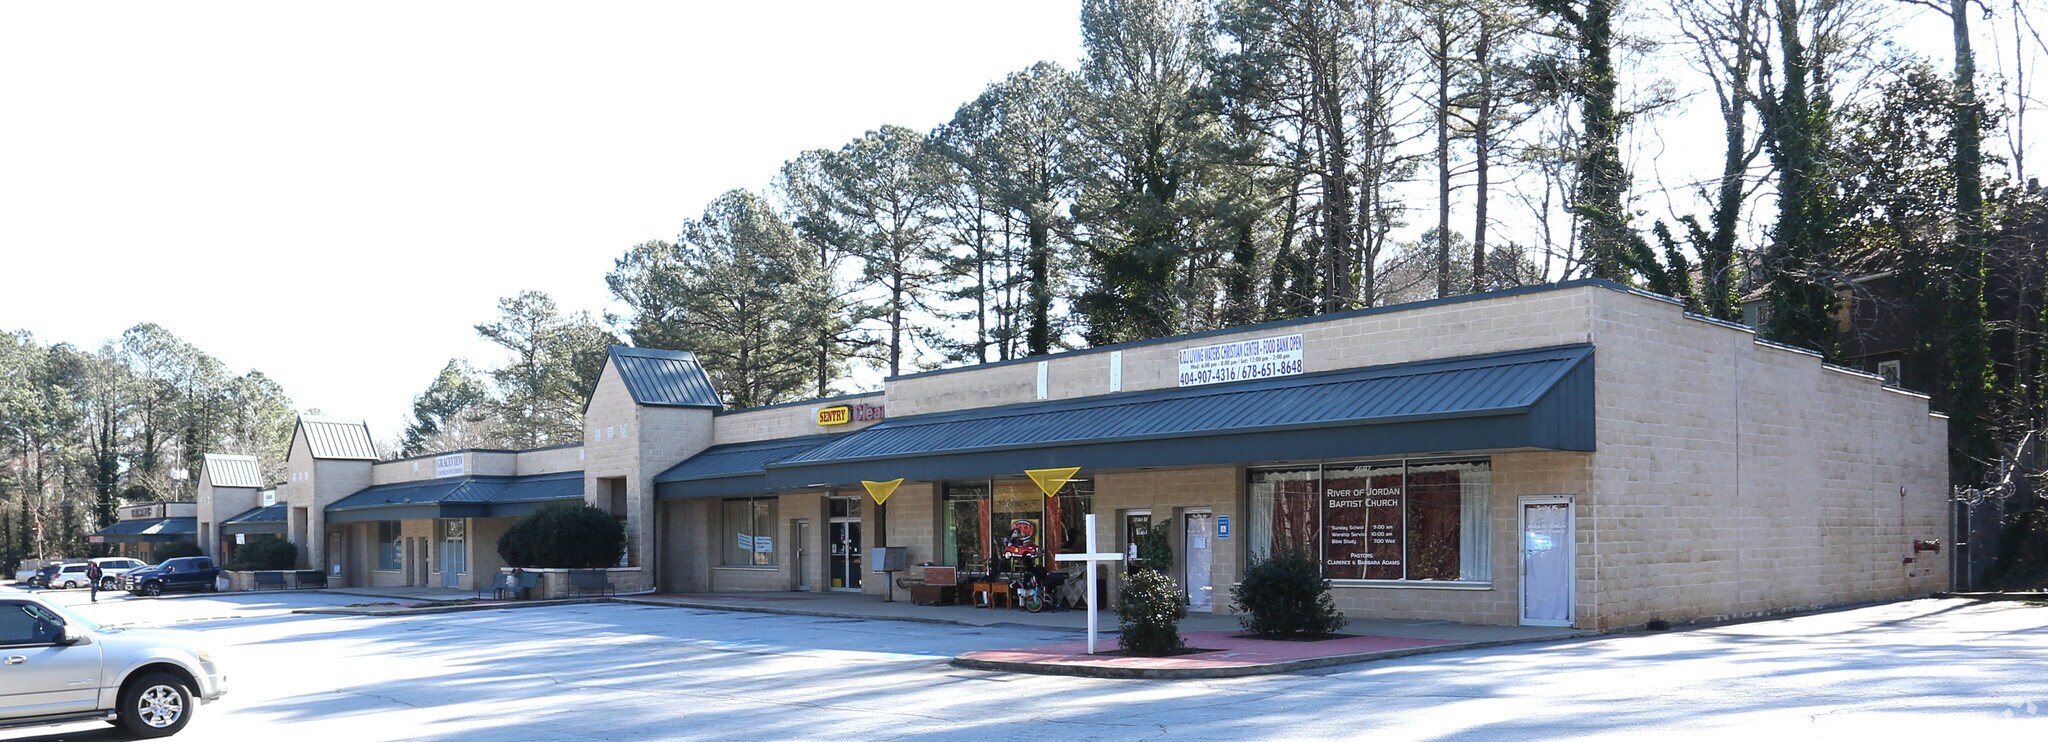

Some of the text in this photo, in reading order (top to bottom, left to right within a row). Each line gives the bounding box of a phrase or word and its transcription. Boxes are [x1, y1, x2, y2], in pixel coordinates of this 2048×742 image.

[1190, 348, 1203, 363] LIVING
[1204, 346, 1220, 361] WATERS
[1221, 342, 1243, 359] CHRISTIAN
[1244, 340, 1259, 357] CENTER
[1263, 339, 1275, 355] FOOD
[1277, 336, 1289, 352] BANK
[1290, 335, 1302, 351] OPEN
[1180, 359, 1302, 386] 404-907-4316 / 678-651-8648
[820, 409, 846, 422] SENTRY
[437, 456, 463, 468] GRACEVIEW
